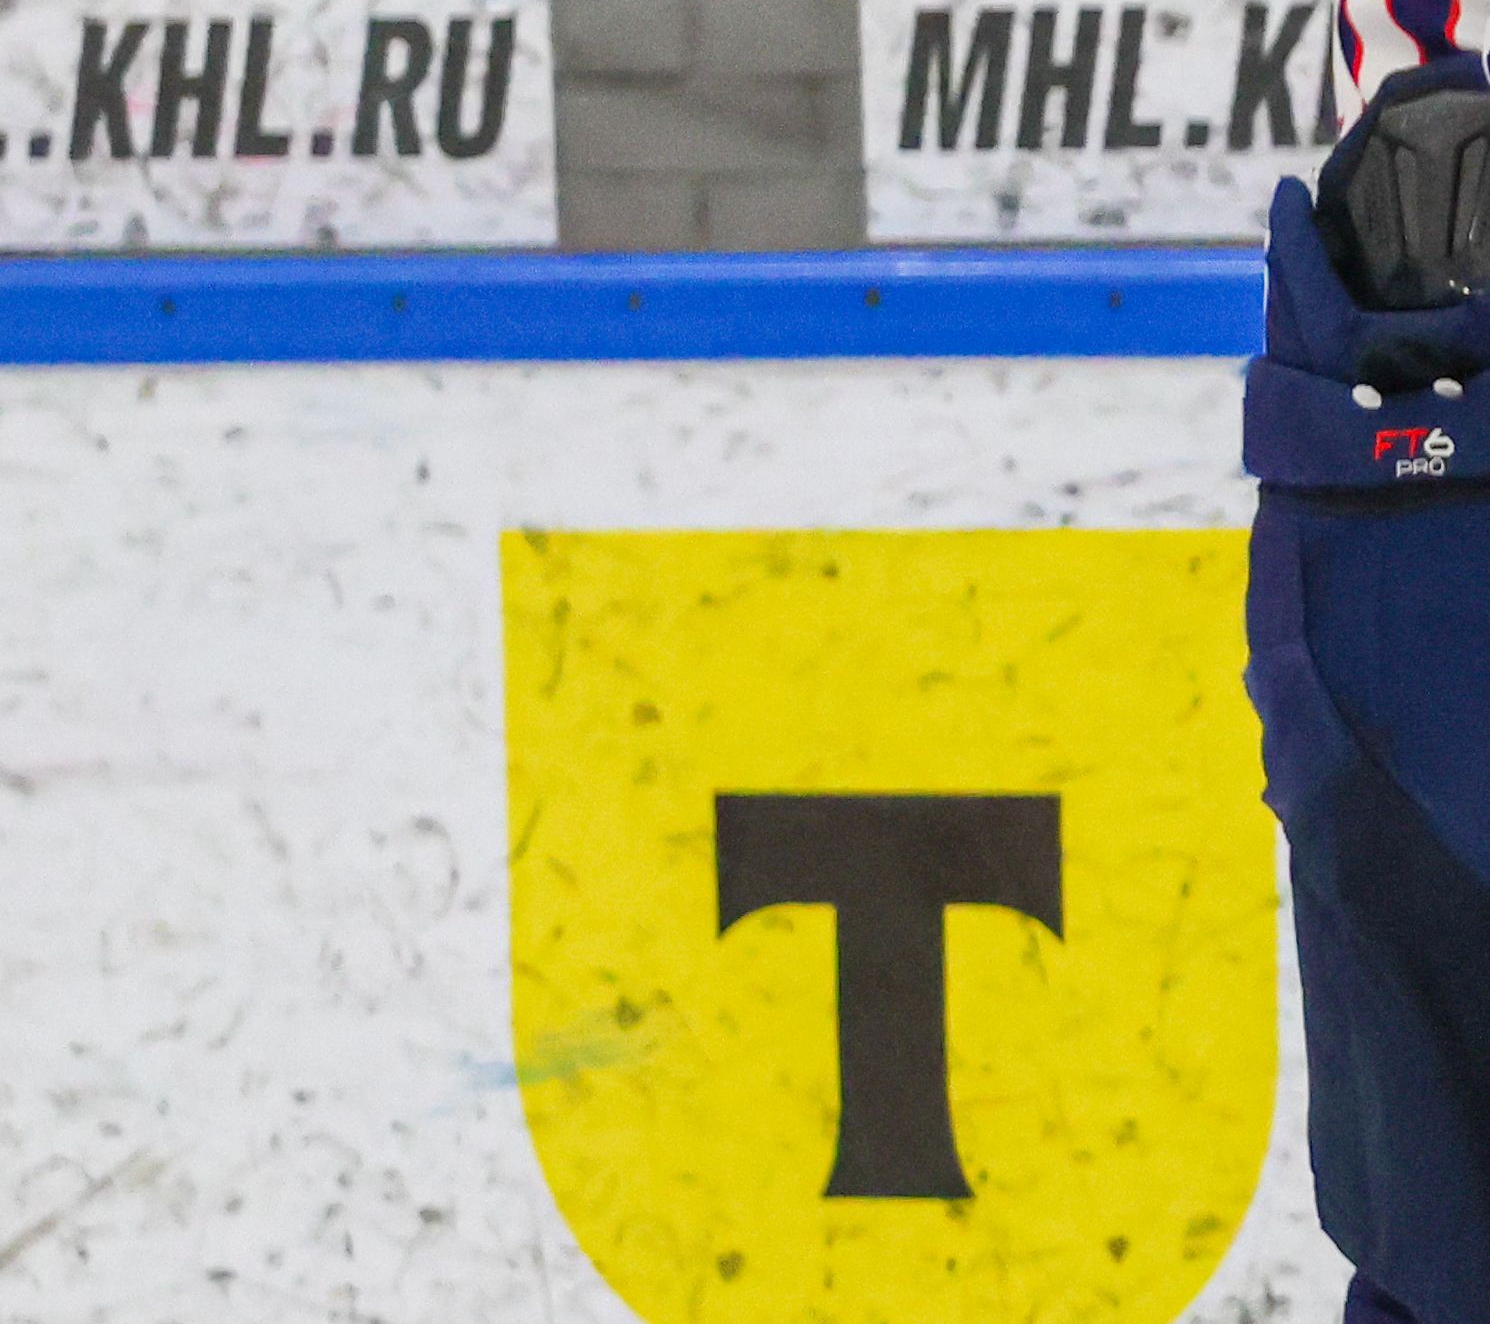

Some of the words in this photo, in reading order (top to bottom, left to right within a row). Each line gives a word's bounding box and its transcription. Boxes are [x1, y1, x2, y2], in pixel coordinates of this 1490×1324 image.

[0, 14, 517, 161] .KHL.RU
[897, 1, 1342, 152] MHL.K
[1373, 427, 1456, 461] FT6
[1395, 456, 1446, 478] PRO
